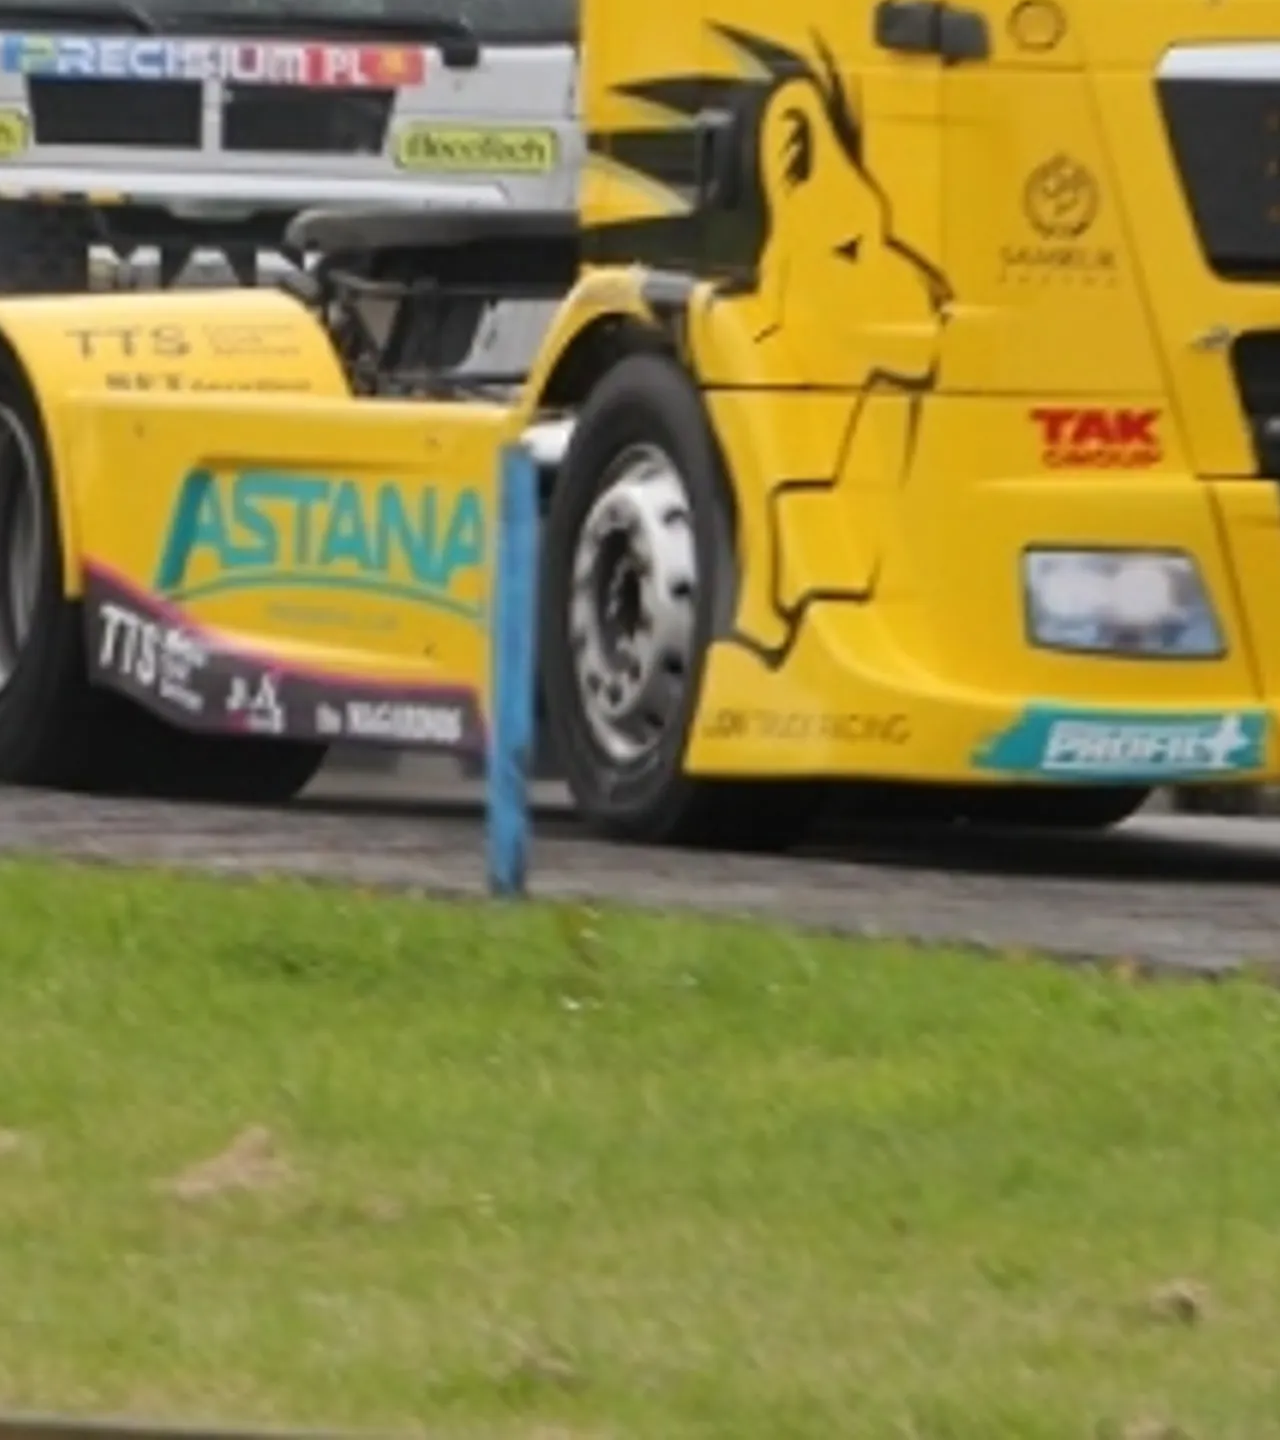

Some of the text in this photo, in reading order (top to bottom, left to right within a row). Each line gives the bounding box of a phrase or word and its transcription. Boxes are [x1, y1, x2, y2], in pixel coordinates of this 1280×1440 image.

[87, 243, 323, 303] MAN
[1028, 407, 1163, 446] TAK
[155, 466, 488, 593] ASTANA
